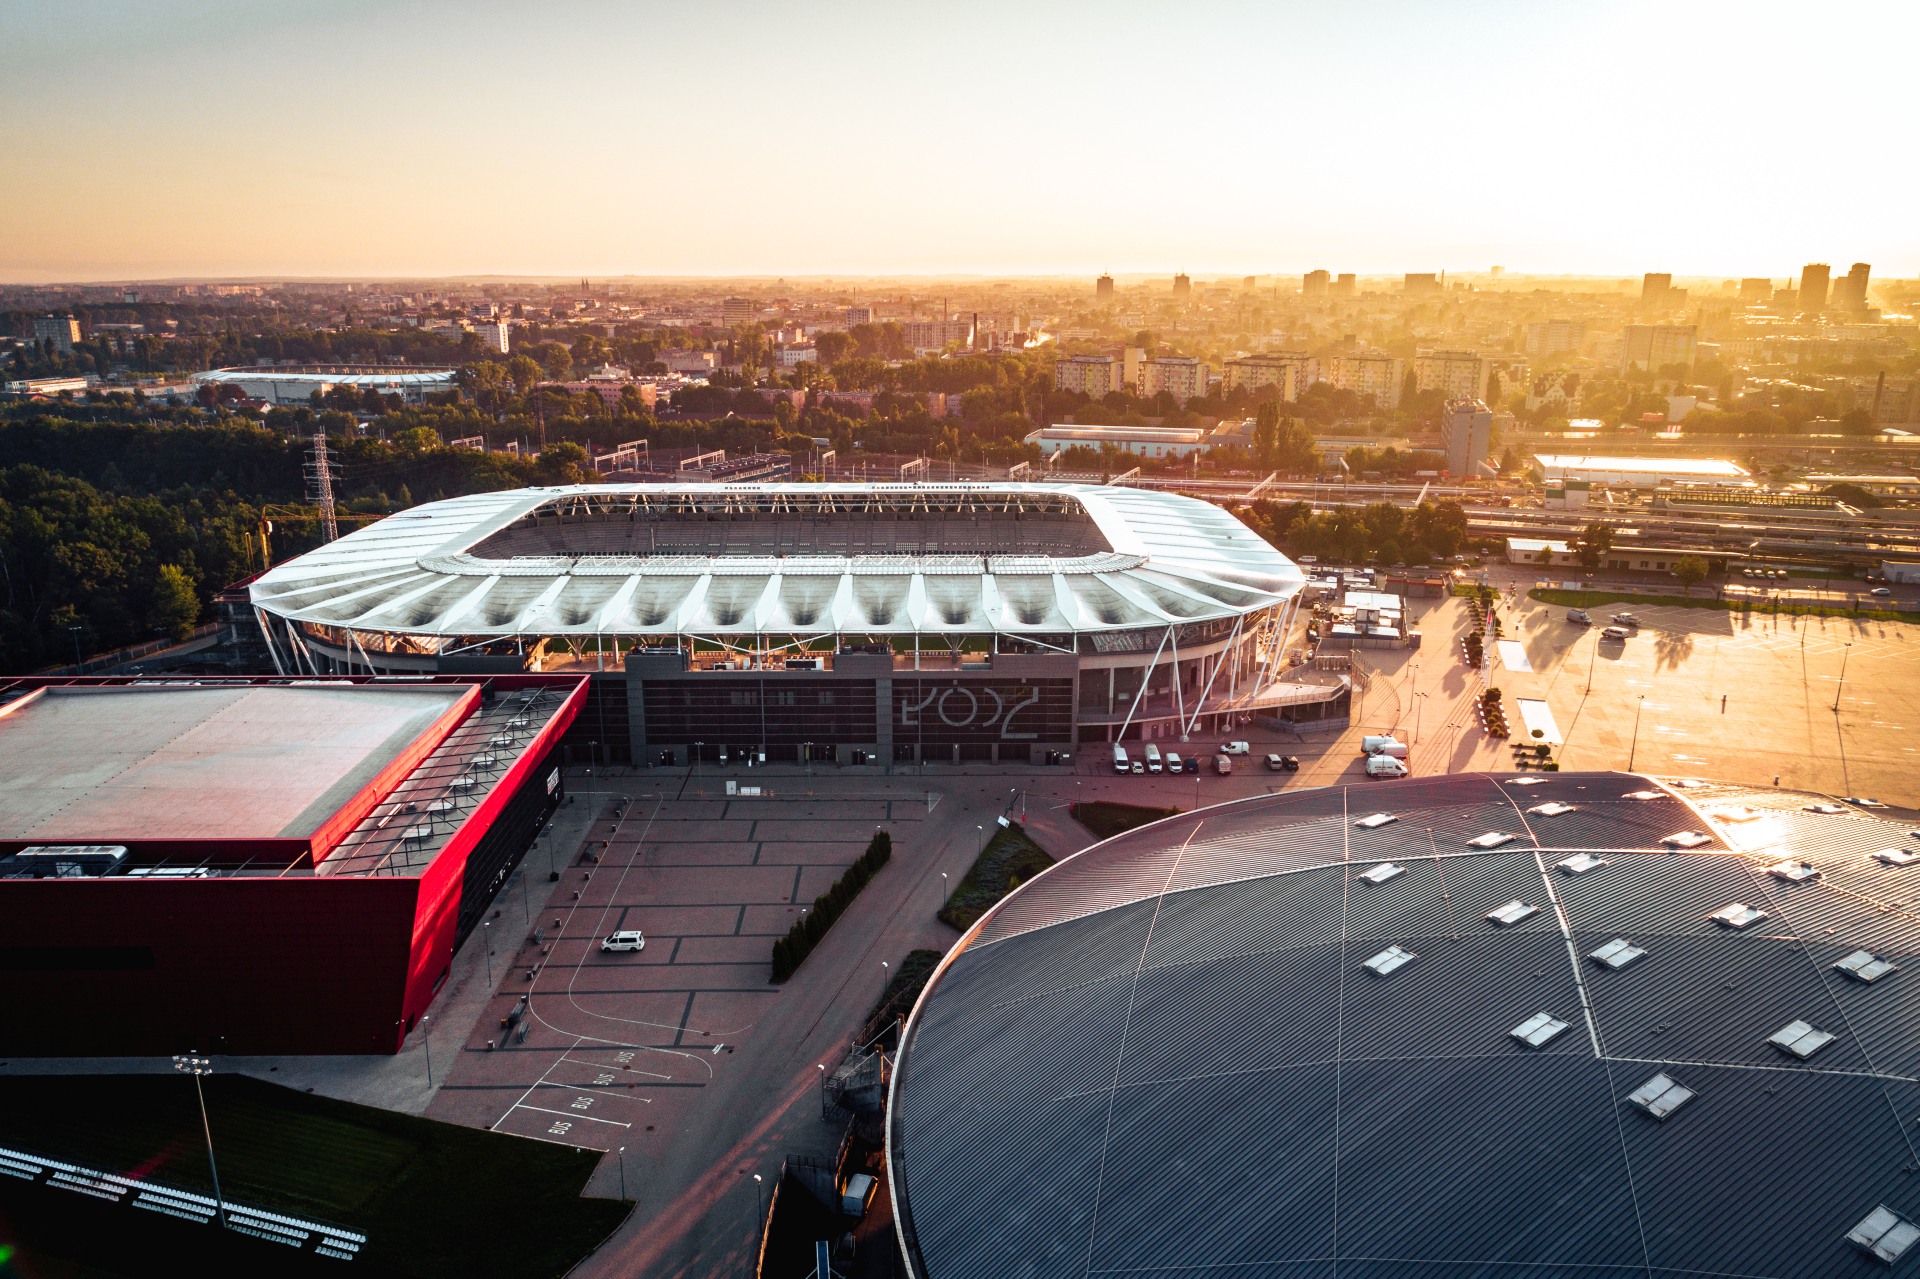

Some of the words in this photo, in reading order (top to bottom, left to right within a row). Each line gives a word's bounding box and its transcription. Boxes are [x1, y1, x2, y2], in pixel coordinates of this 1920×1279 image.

[614, 1052, 635, 1063] BUS
[593, 1074, 615, 1086] BUS
[571, 1097, 594, 1109] BUS
[548, 1122, 572, 1135] BUS
